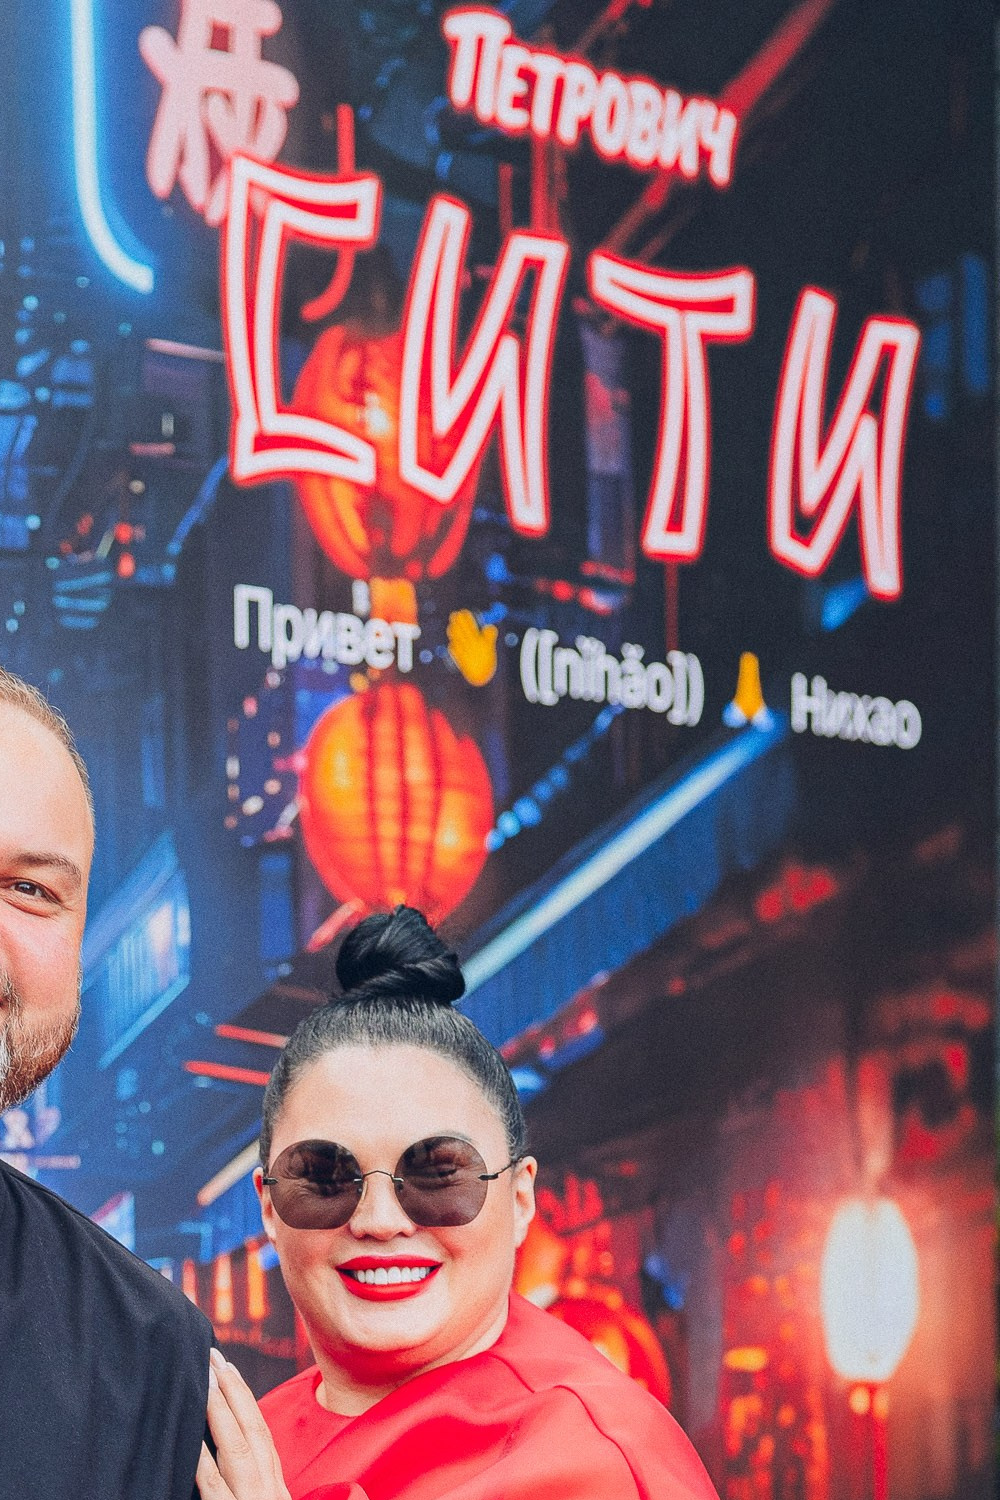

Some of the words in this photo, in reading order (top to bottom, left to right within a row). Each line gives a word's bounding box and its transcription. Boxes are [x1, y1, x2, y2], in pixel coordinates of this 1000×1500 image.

[442, 11, 739, 186] ПЕТРОВИЧ
[228, 154, 920, 598] СИТИ
[233, 583, 422, 673] Привет
[790, 671, 923, 750] Нихао
